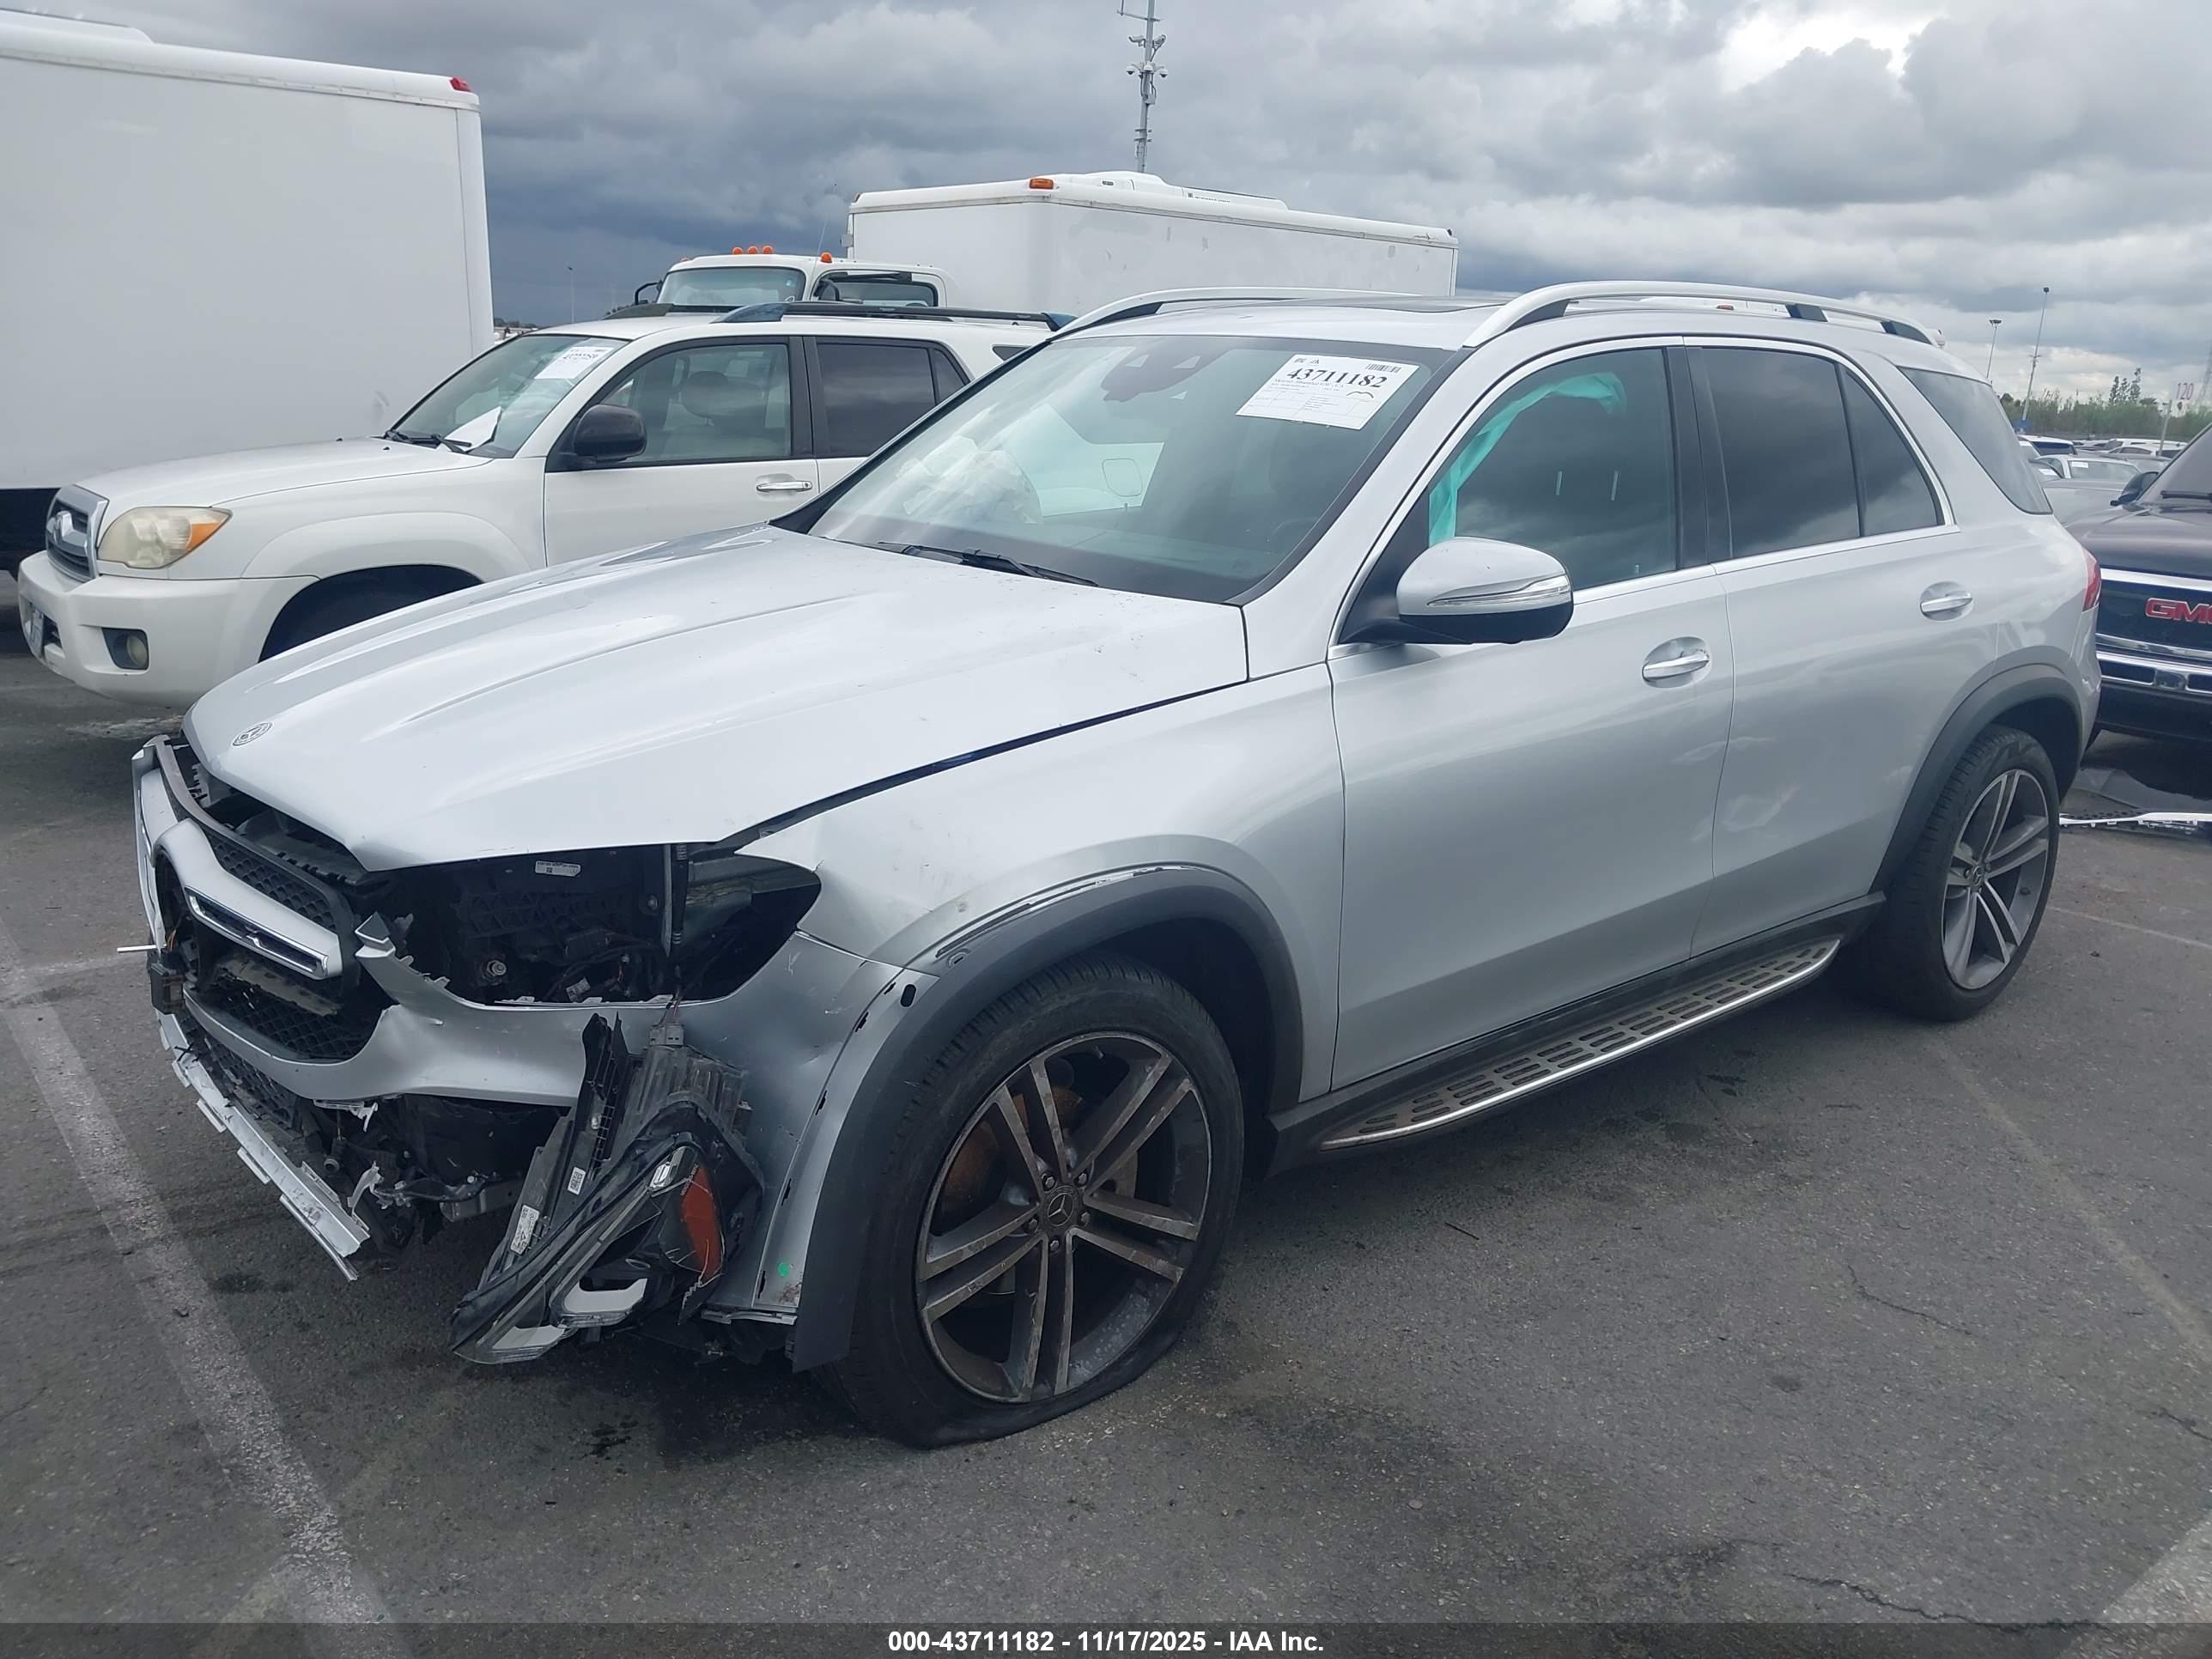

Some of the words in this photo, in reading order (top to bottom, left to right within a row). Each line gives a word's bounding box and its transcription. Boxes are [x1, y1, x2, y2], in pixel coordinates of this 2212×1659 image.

[1286, 367, 1388, 389] 43711182
[2176, 382, 2195, 401] 120
[2145, 598, 2212, 625] GM
